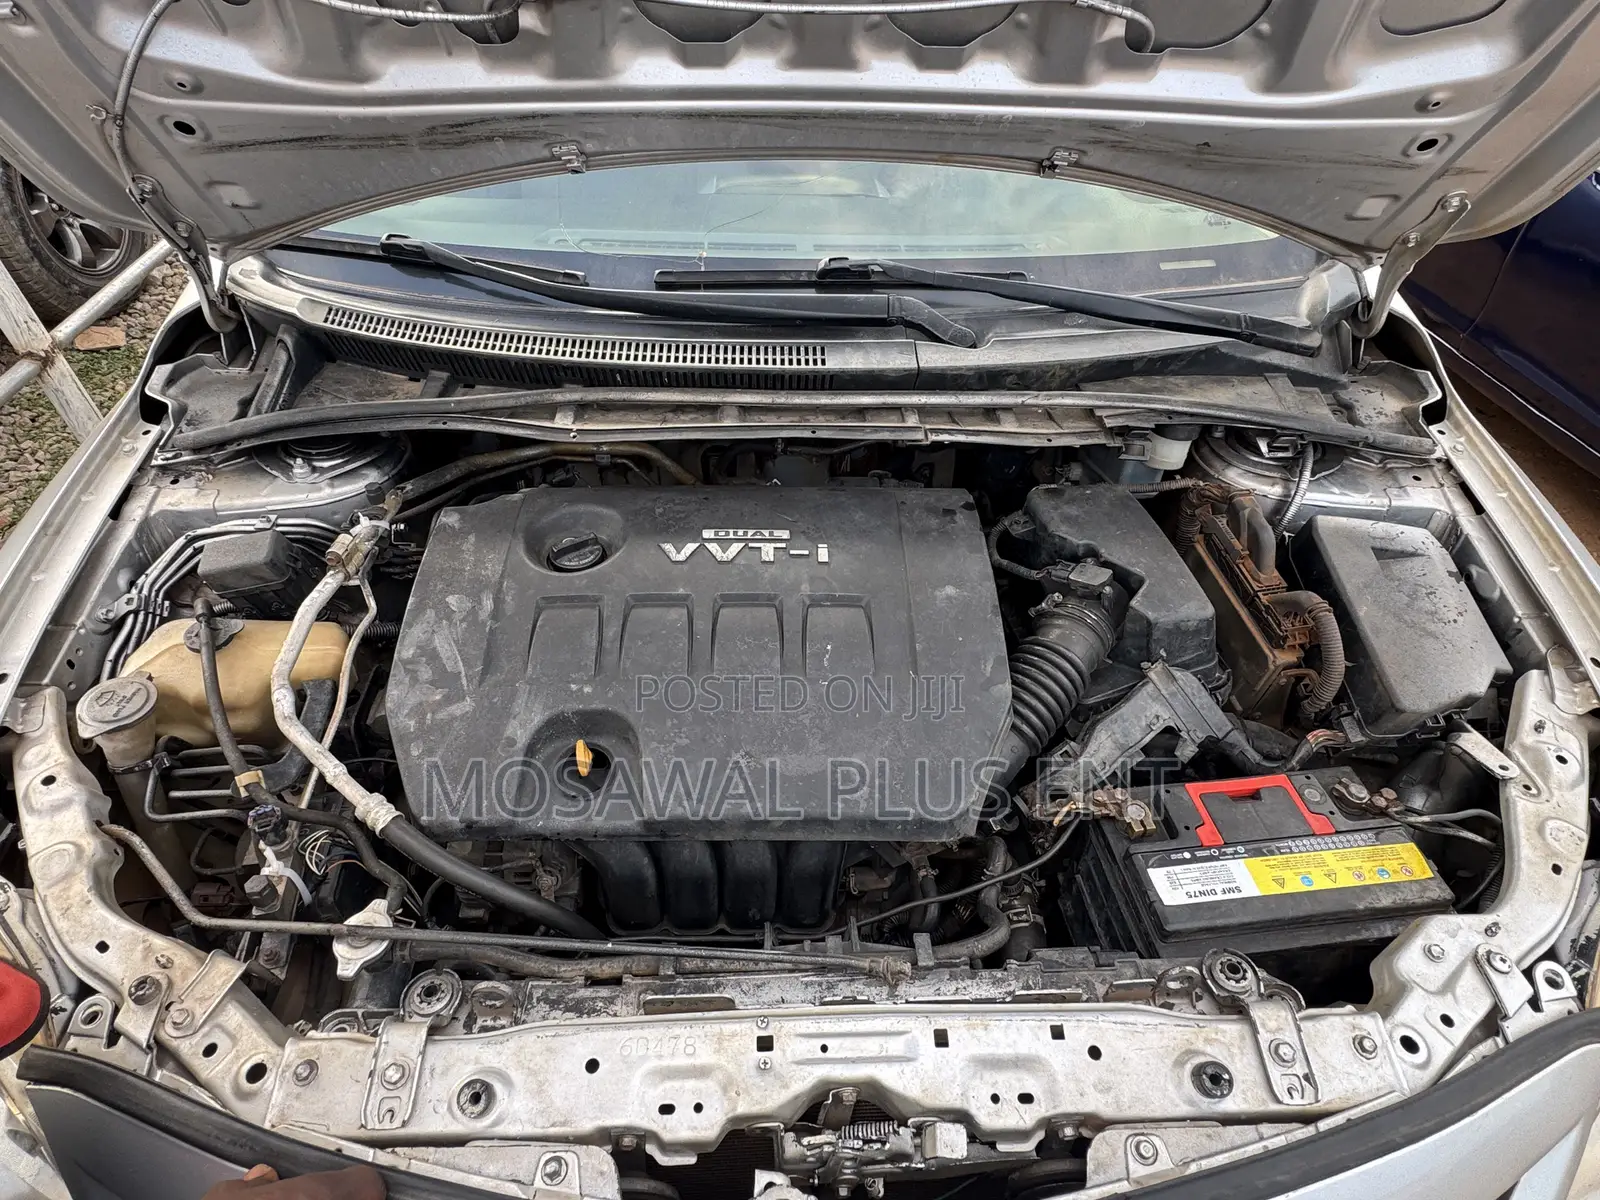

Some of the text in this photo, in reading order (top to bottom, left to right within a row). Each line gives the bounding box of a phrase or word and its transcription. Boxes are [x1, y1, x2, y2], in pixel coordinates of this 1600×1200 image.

[712, 529, 784, 538] DUAL
[1185, 885, 1243, 899] SMF DIN75
